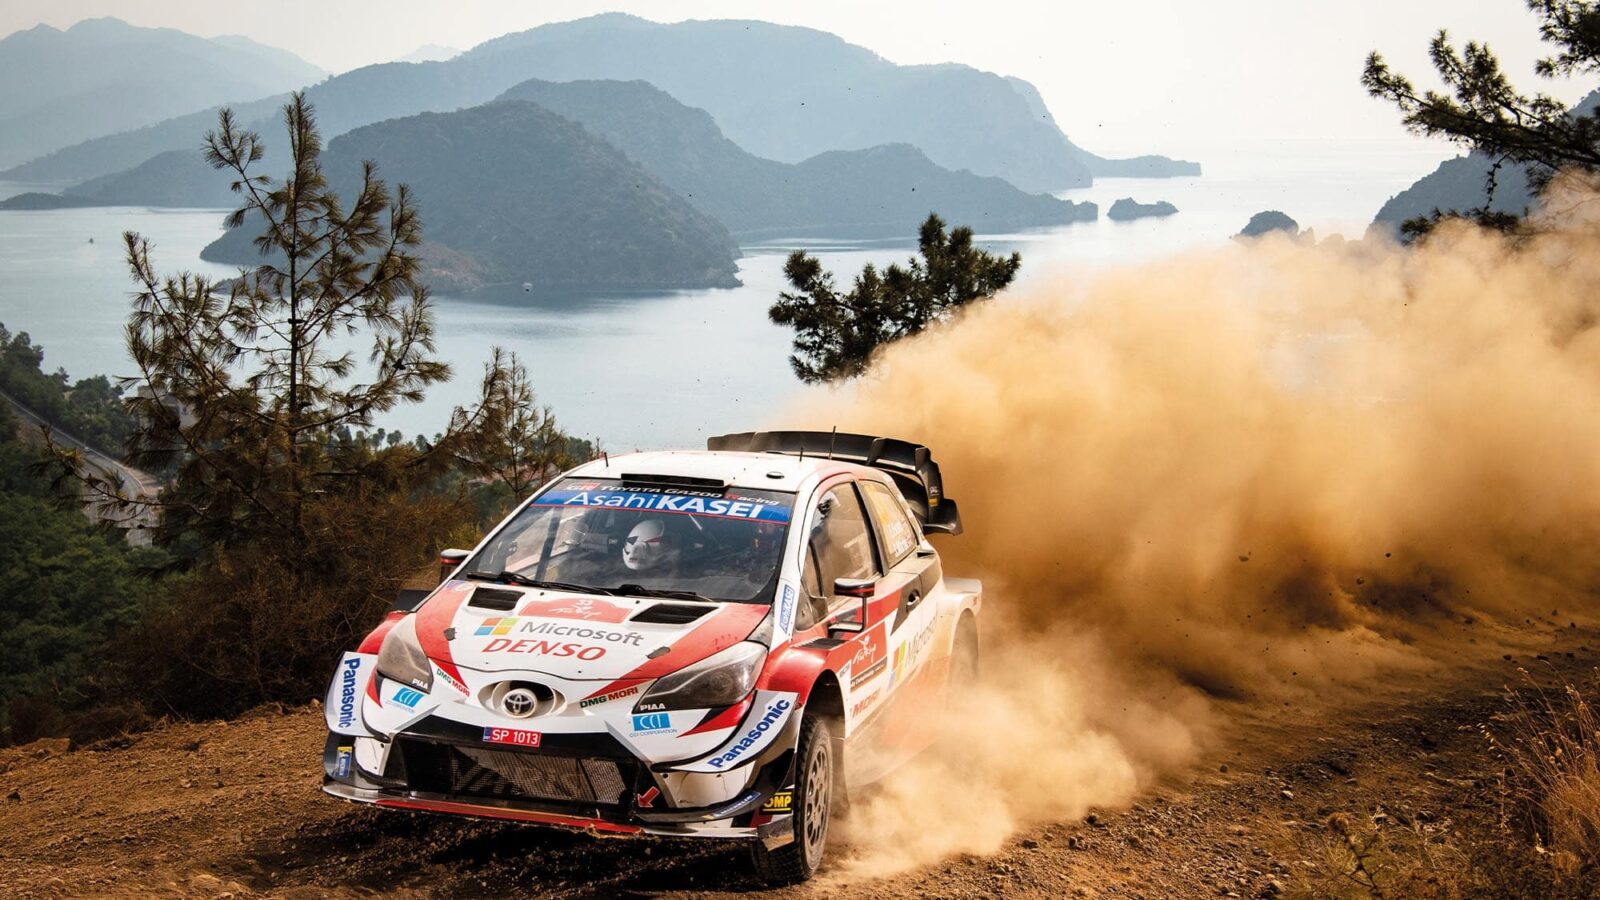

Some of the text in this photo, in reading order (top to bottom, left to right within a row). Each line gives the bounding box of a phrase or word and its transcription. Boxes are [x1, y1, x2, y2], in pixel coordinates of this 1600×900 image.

[600, 485, 661, 494] TOYOTA
[663, 488, 723, 498] GAZOO
[564, 491, 764, 519] AsahiKASEI
[520, 621, 644, 647] Microsoft
[481, 638, 606, 661] DENSO
[411, 678, 429, 689] PIAA
[436, 668, 452, 684] DMG
[338, 657, 361, 729] Panasonic
[579, 686, 639, 709] DMG MORI
[639, 702, 666, 711] PIAA
[492, 729, 509, 741] SP
[513, 731, 538, 745] 1013
[706, 699, 790, 768] Panasonic
